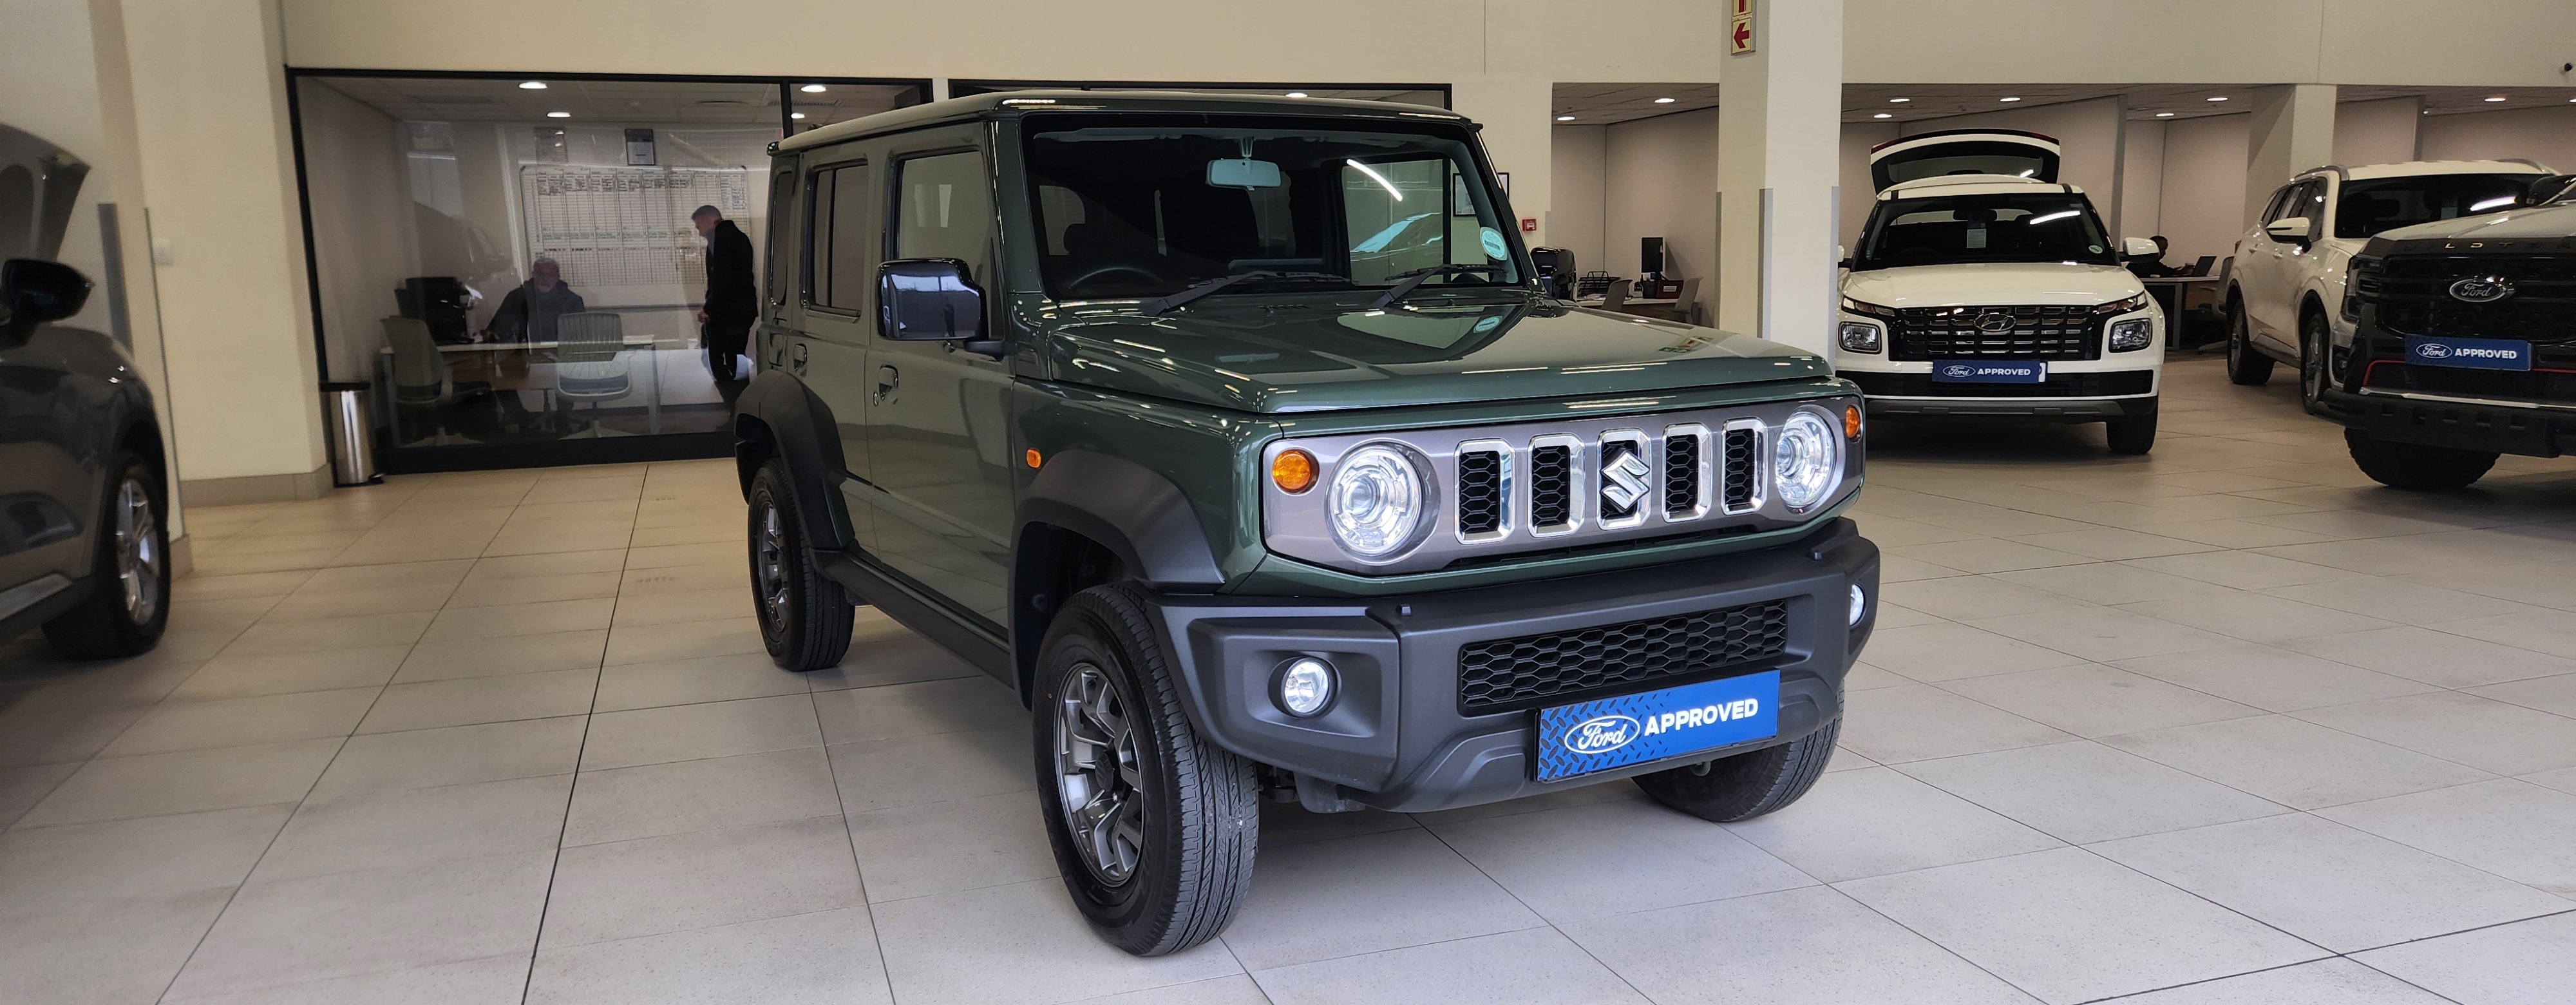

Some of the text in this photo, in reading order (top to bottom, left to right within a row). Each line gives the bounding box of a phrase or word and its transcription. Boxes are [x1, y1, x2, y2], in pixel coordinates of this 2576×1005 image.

[2460, 283, 2492, 298] Ford
[2422, 343, 2517, 359] Ford APPROVED
[1947, 365, 1970, 376] Ford
[1577, 698, 1759, 750] Ford APPROVED
